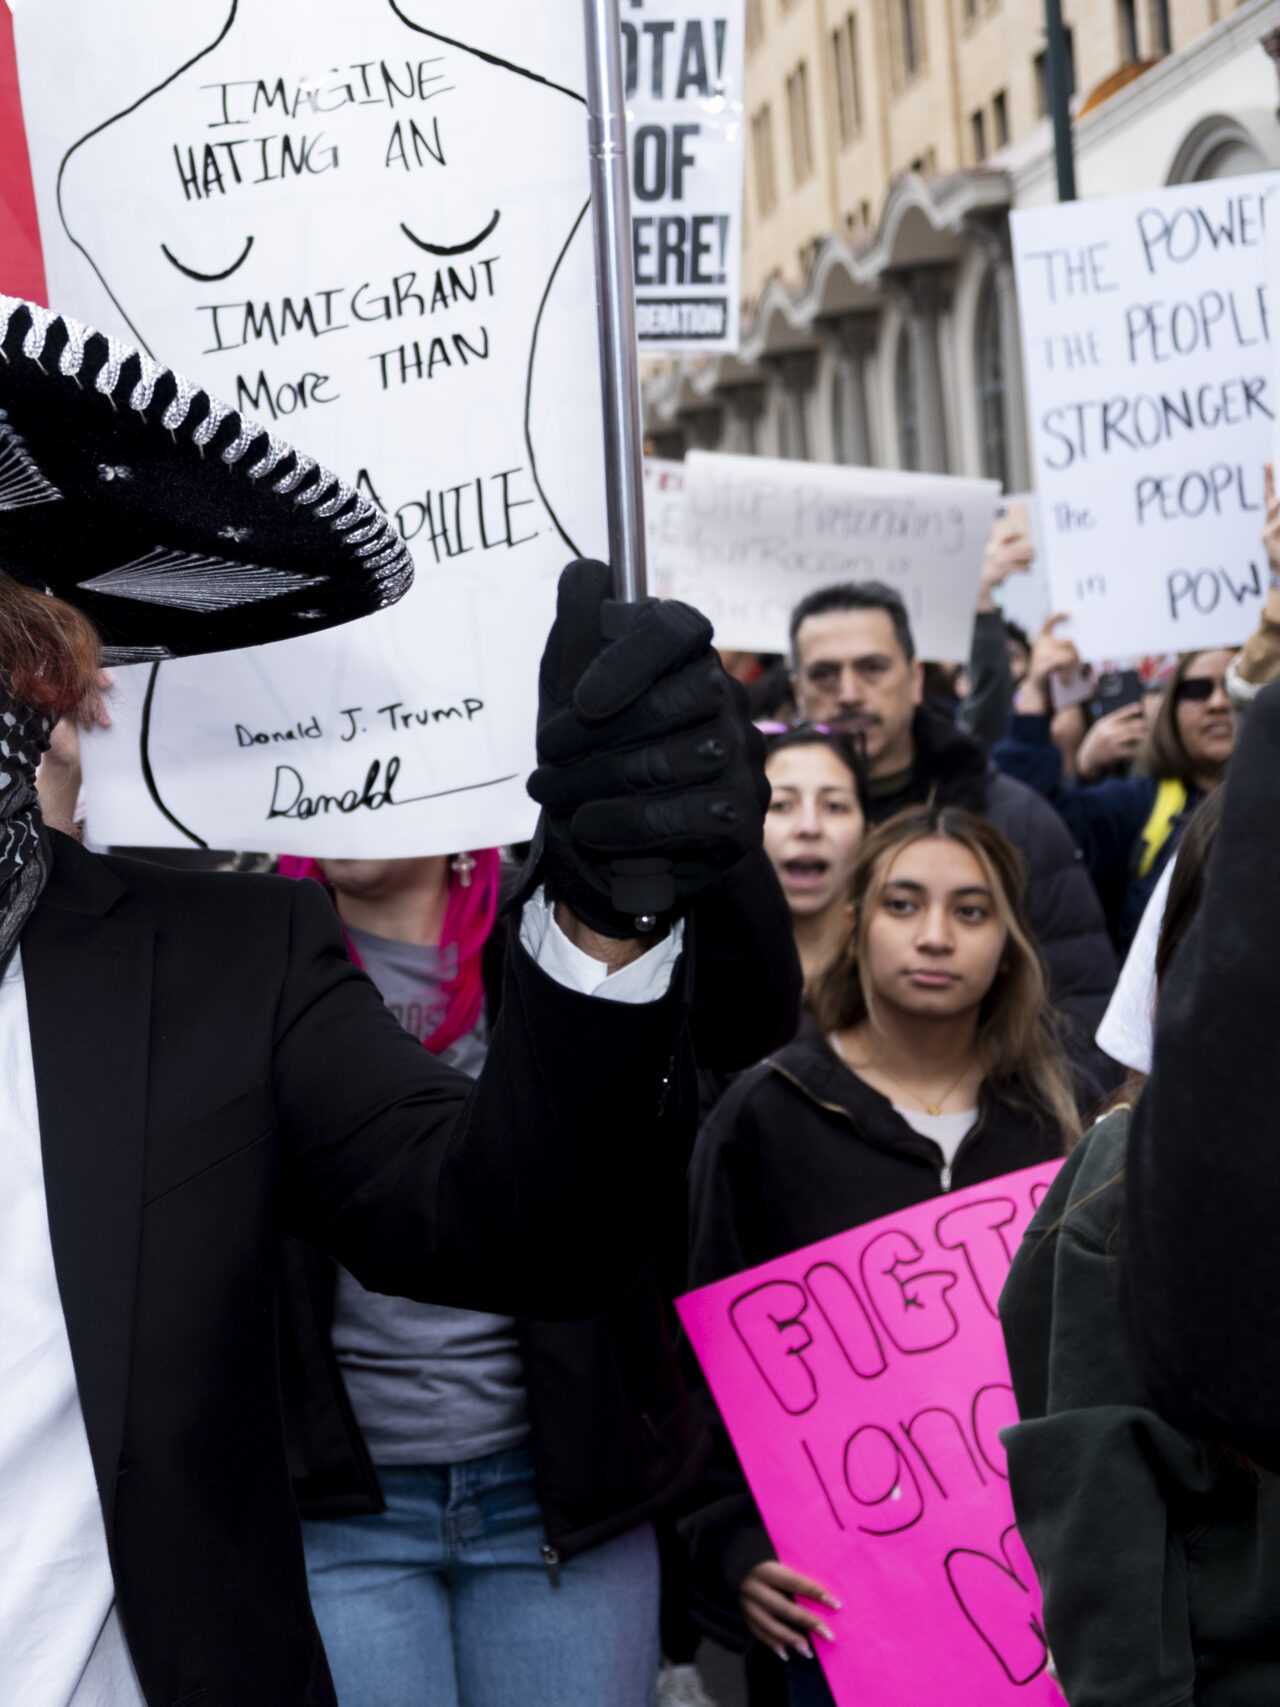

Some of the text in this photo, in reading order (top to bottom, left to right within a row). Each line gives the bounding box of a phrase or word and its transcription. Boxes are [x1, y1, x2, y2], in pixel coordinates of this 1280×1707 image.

[200, 57, 456, 127] IMAGINE
[173, 116, 446, 201] HATING AN
[633, 124, 700, 202] OF
[195, 256, 500, 354] IMMIGRANT
[1024, 240, 1120, 305] THE
[368, 326, 489, 390] THAN
[1042, 376, 1276, 470] STRONGER
[1136, 464, 1261, 525] PEOPL
[1168, 560, 1263, 622] POW
[235, 716, 322, 748] Donald
[340, 707, 367, 742] J.
[729, 1183, 1048, 1415] FIGT
